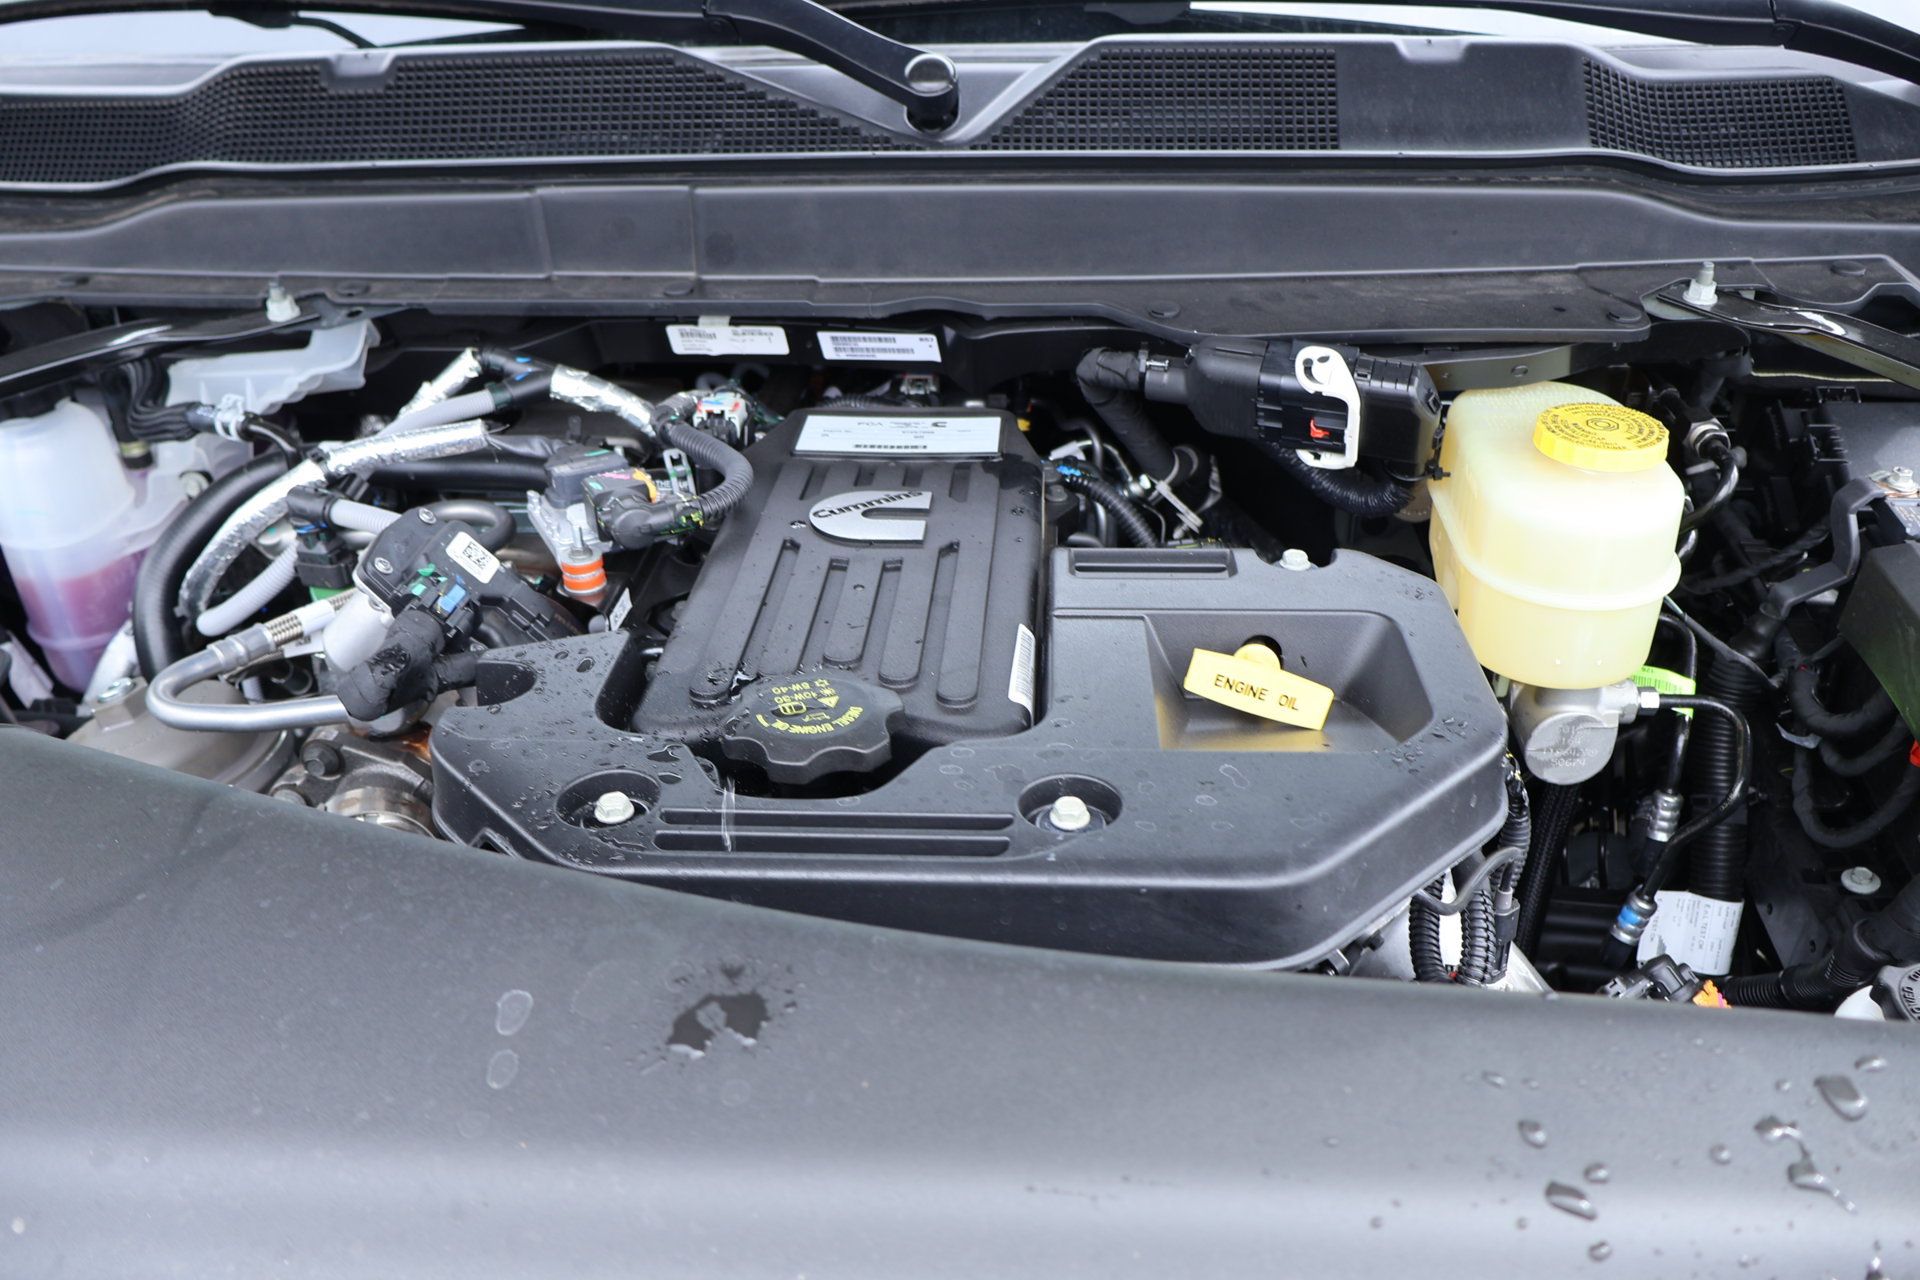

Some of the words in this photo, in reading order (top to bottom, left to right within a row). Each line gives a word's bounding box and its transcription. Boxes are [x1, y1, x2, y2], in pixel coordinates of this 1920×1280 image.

[812, 490, 924, 519] Cummins
[1213, 673, 1269, 702] ENGINE
[1278, 693, 1299, 711] OIL
[788, 722, 835, 734] ENGINE
[832, 706, 864, 727] DIESEL
